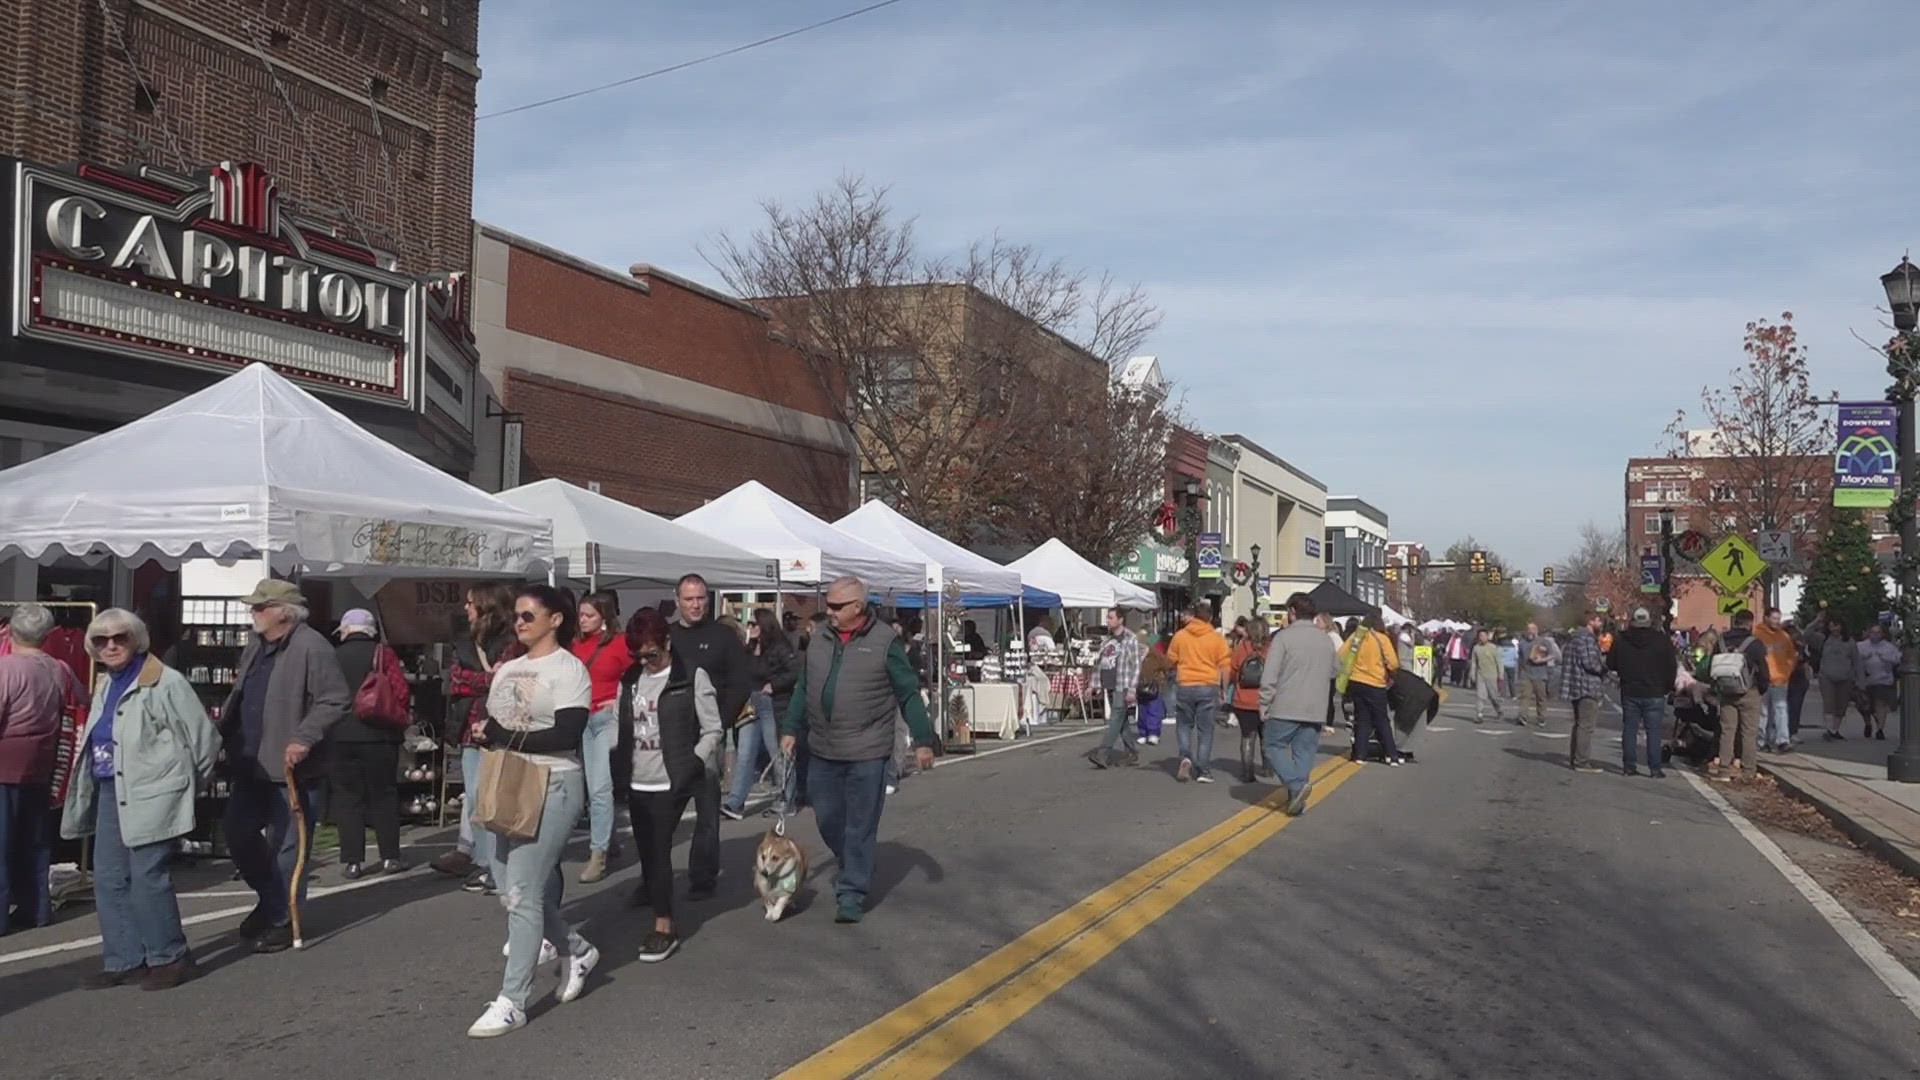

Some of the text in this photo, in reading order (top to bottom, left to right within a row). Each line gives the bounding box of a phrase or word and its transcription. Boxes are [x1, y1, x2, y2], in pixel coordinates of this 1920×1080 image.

[45, 195, 403, 337] CAPITOL
[1841, 474, 1889, 486] Maryville
[1127, 566, 1140, 574] THE
[1119, 573, 1147, 581] PALACE
[416, 581, 460, 604] DSB
